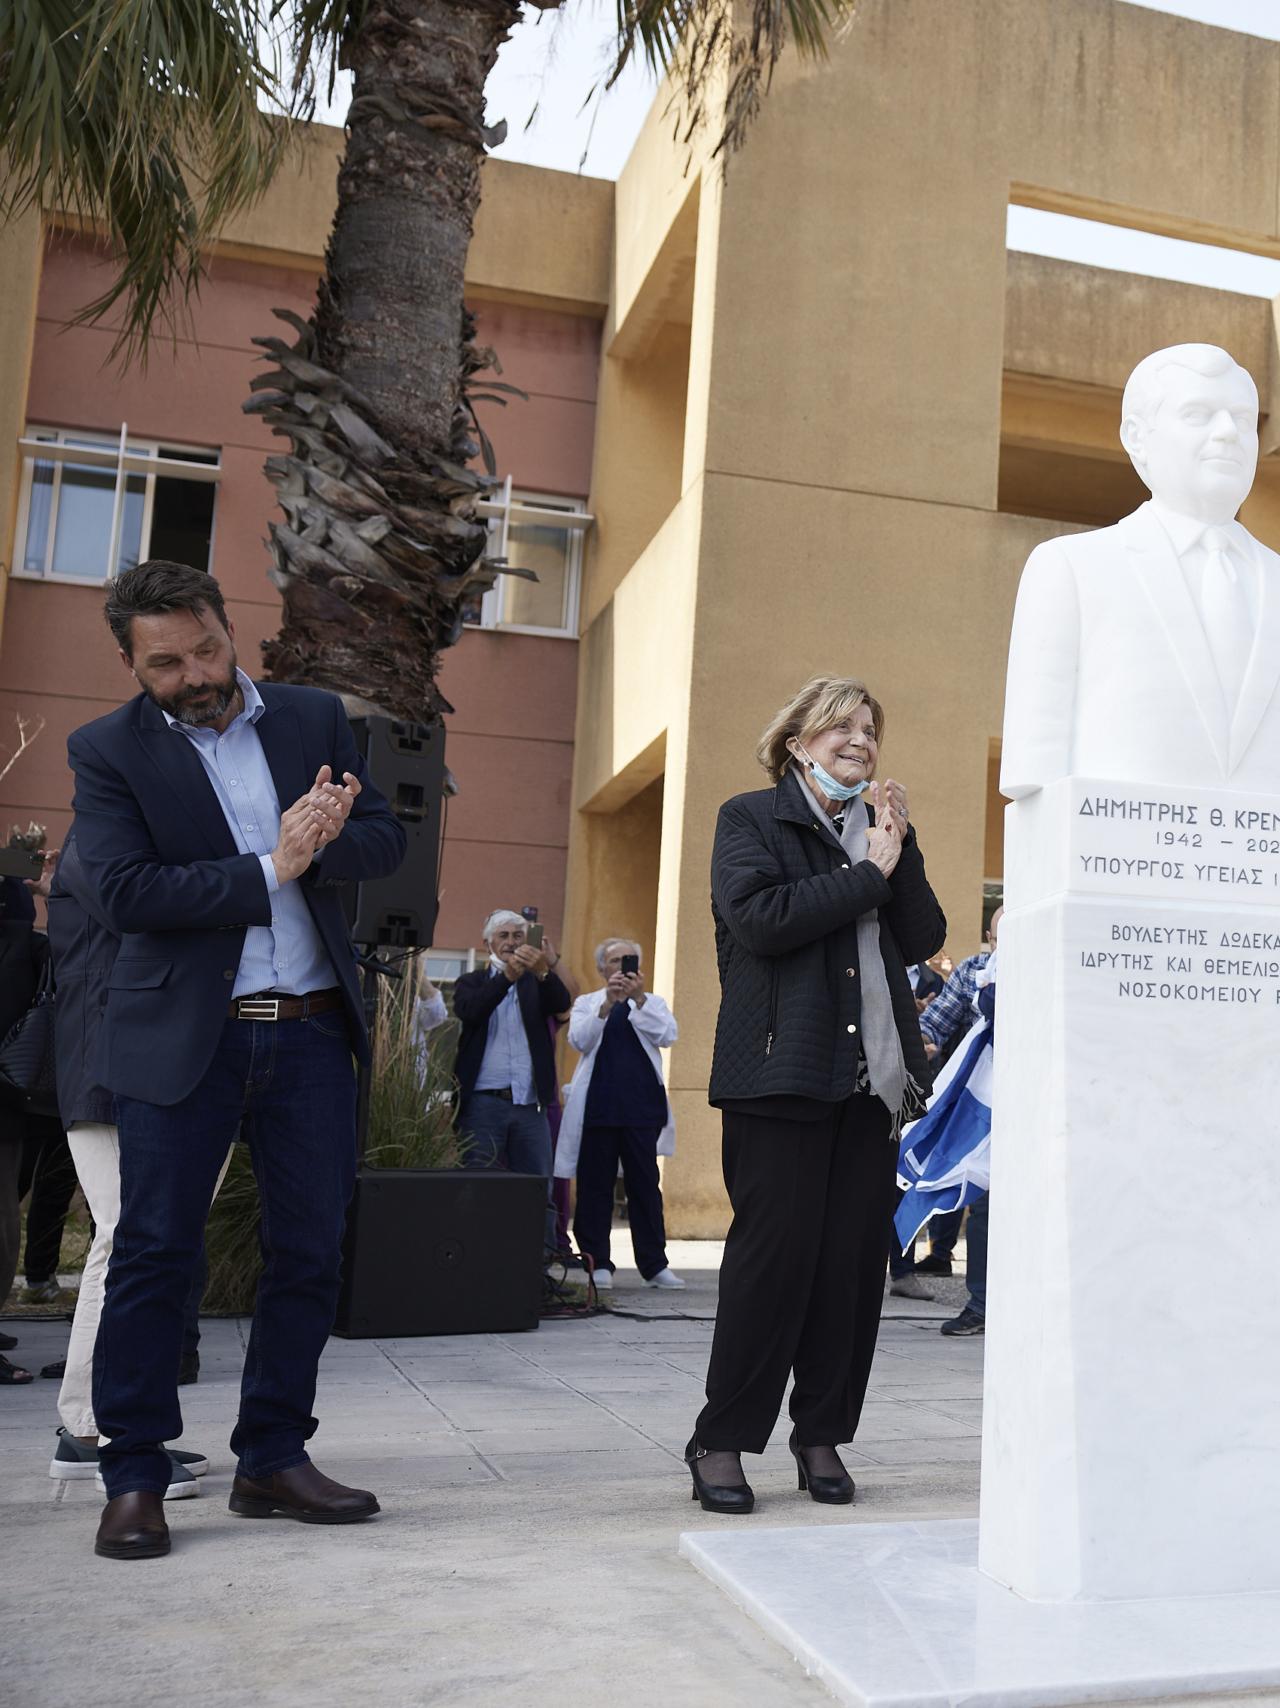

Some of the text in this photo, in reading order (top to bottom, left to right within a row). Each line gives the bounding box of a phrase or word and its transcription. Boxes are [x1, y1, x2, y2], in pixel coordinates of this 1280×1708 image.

[1078, 796, 1198, 825] ΔΗΜΗΤΡΗΣ
[1209, 807, 1226, 828] Θ.
[1156, 831, 1203, 848] 1942
[1079, 855, 1185, 880] ΥΠΟΥΡΓΟΣ
[1193, 863, 1263, 885] ΥΓΕΙΑΣ
[1111, 924, 1208, 946] ΒΟΥΛΕΥΤΗΣ
[1081, 951, 1154, 971] ΙΔΡΥΤΗΣ
[1167, 955, 1192, 973] ΚΑΙ
[1118, 981, 1262, 1004] ΝΟΣΟΚΟΜΕΙΟΥ
